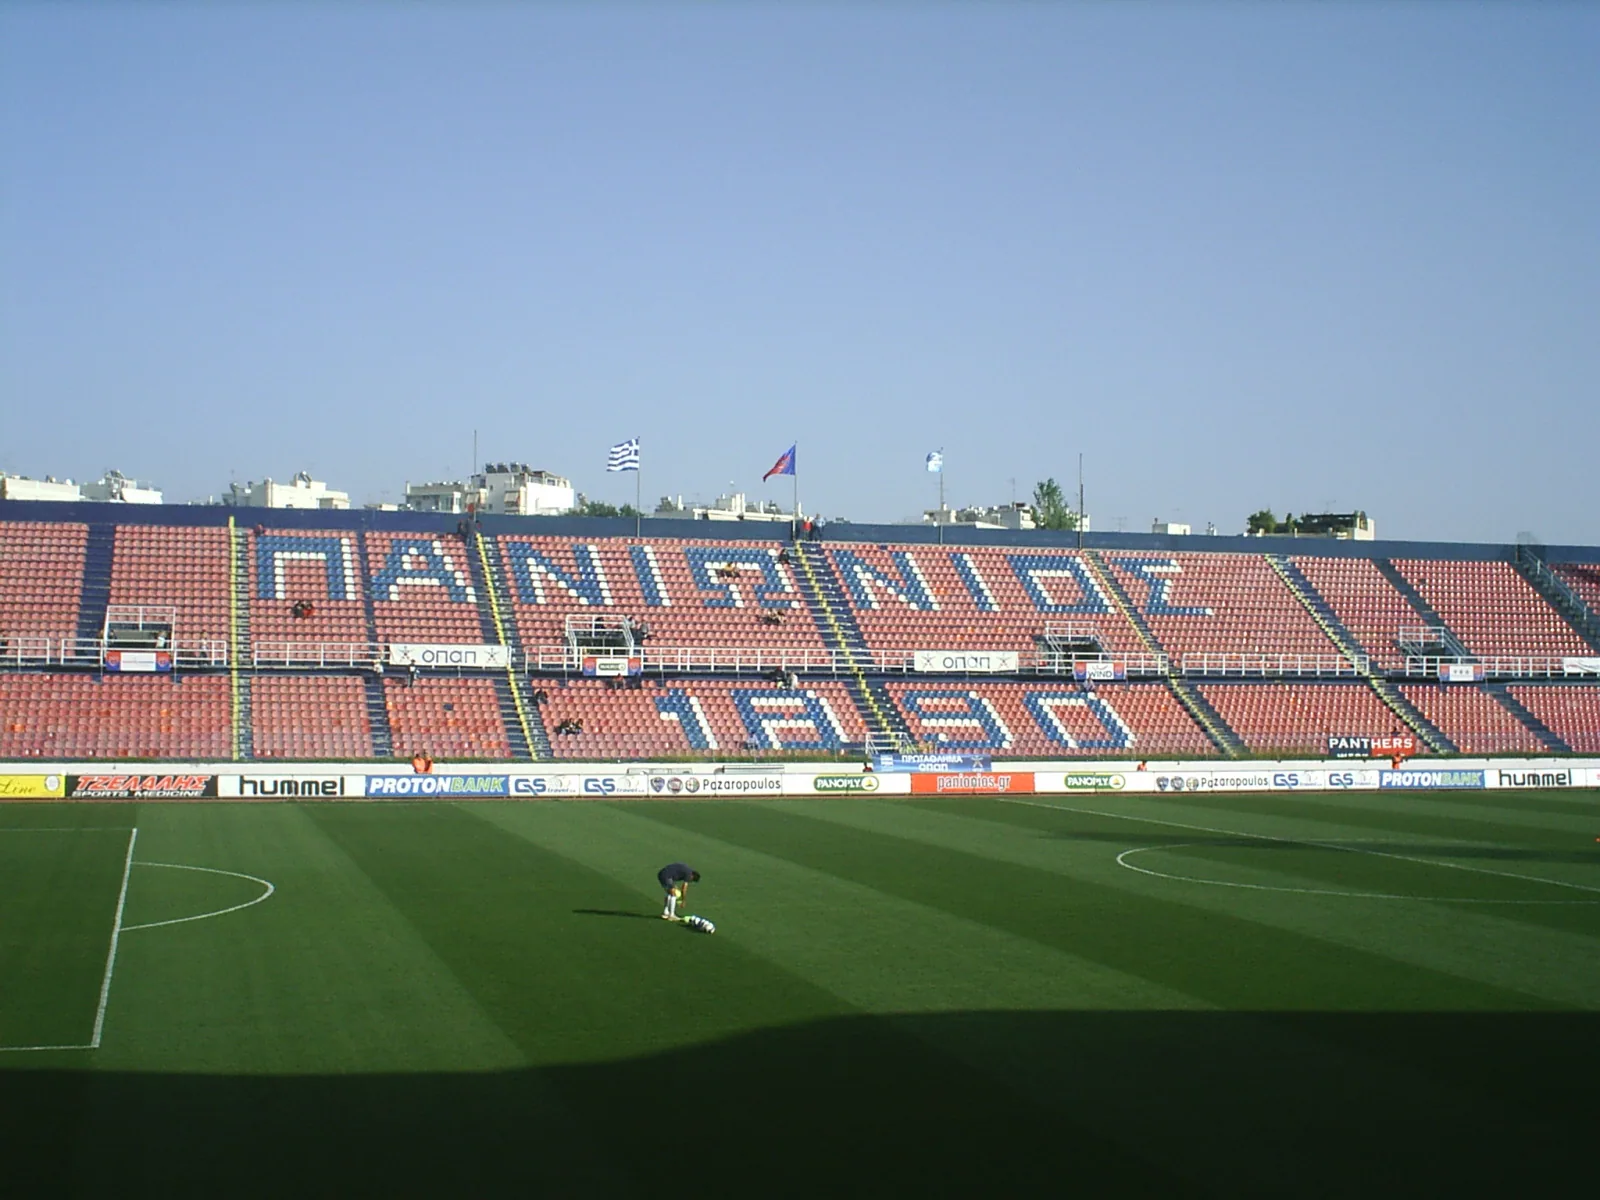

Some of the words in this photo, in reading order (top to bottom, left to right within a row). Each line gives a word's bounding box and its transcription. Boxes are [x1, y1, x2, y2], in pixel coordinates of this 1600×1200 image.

[1329, 738, 1413, 749] PANTHERS
[816, 780, 861, 788] PANOPLY
[937, 775, 1011, 789] panionios.gr
[1067, 777, 1110, 786] PANOPLY
[1201, 776, 1268, 789] Pazaropoulos
[1499, 769, 1572, 786] hummel
[239, 775, 345, 796] hummel
[369, 777, 504, 794] PROTONBANK
[703, 778, 781, 791] Pazaropoulos
